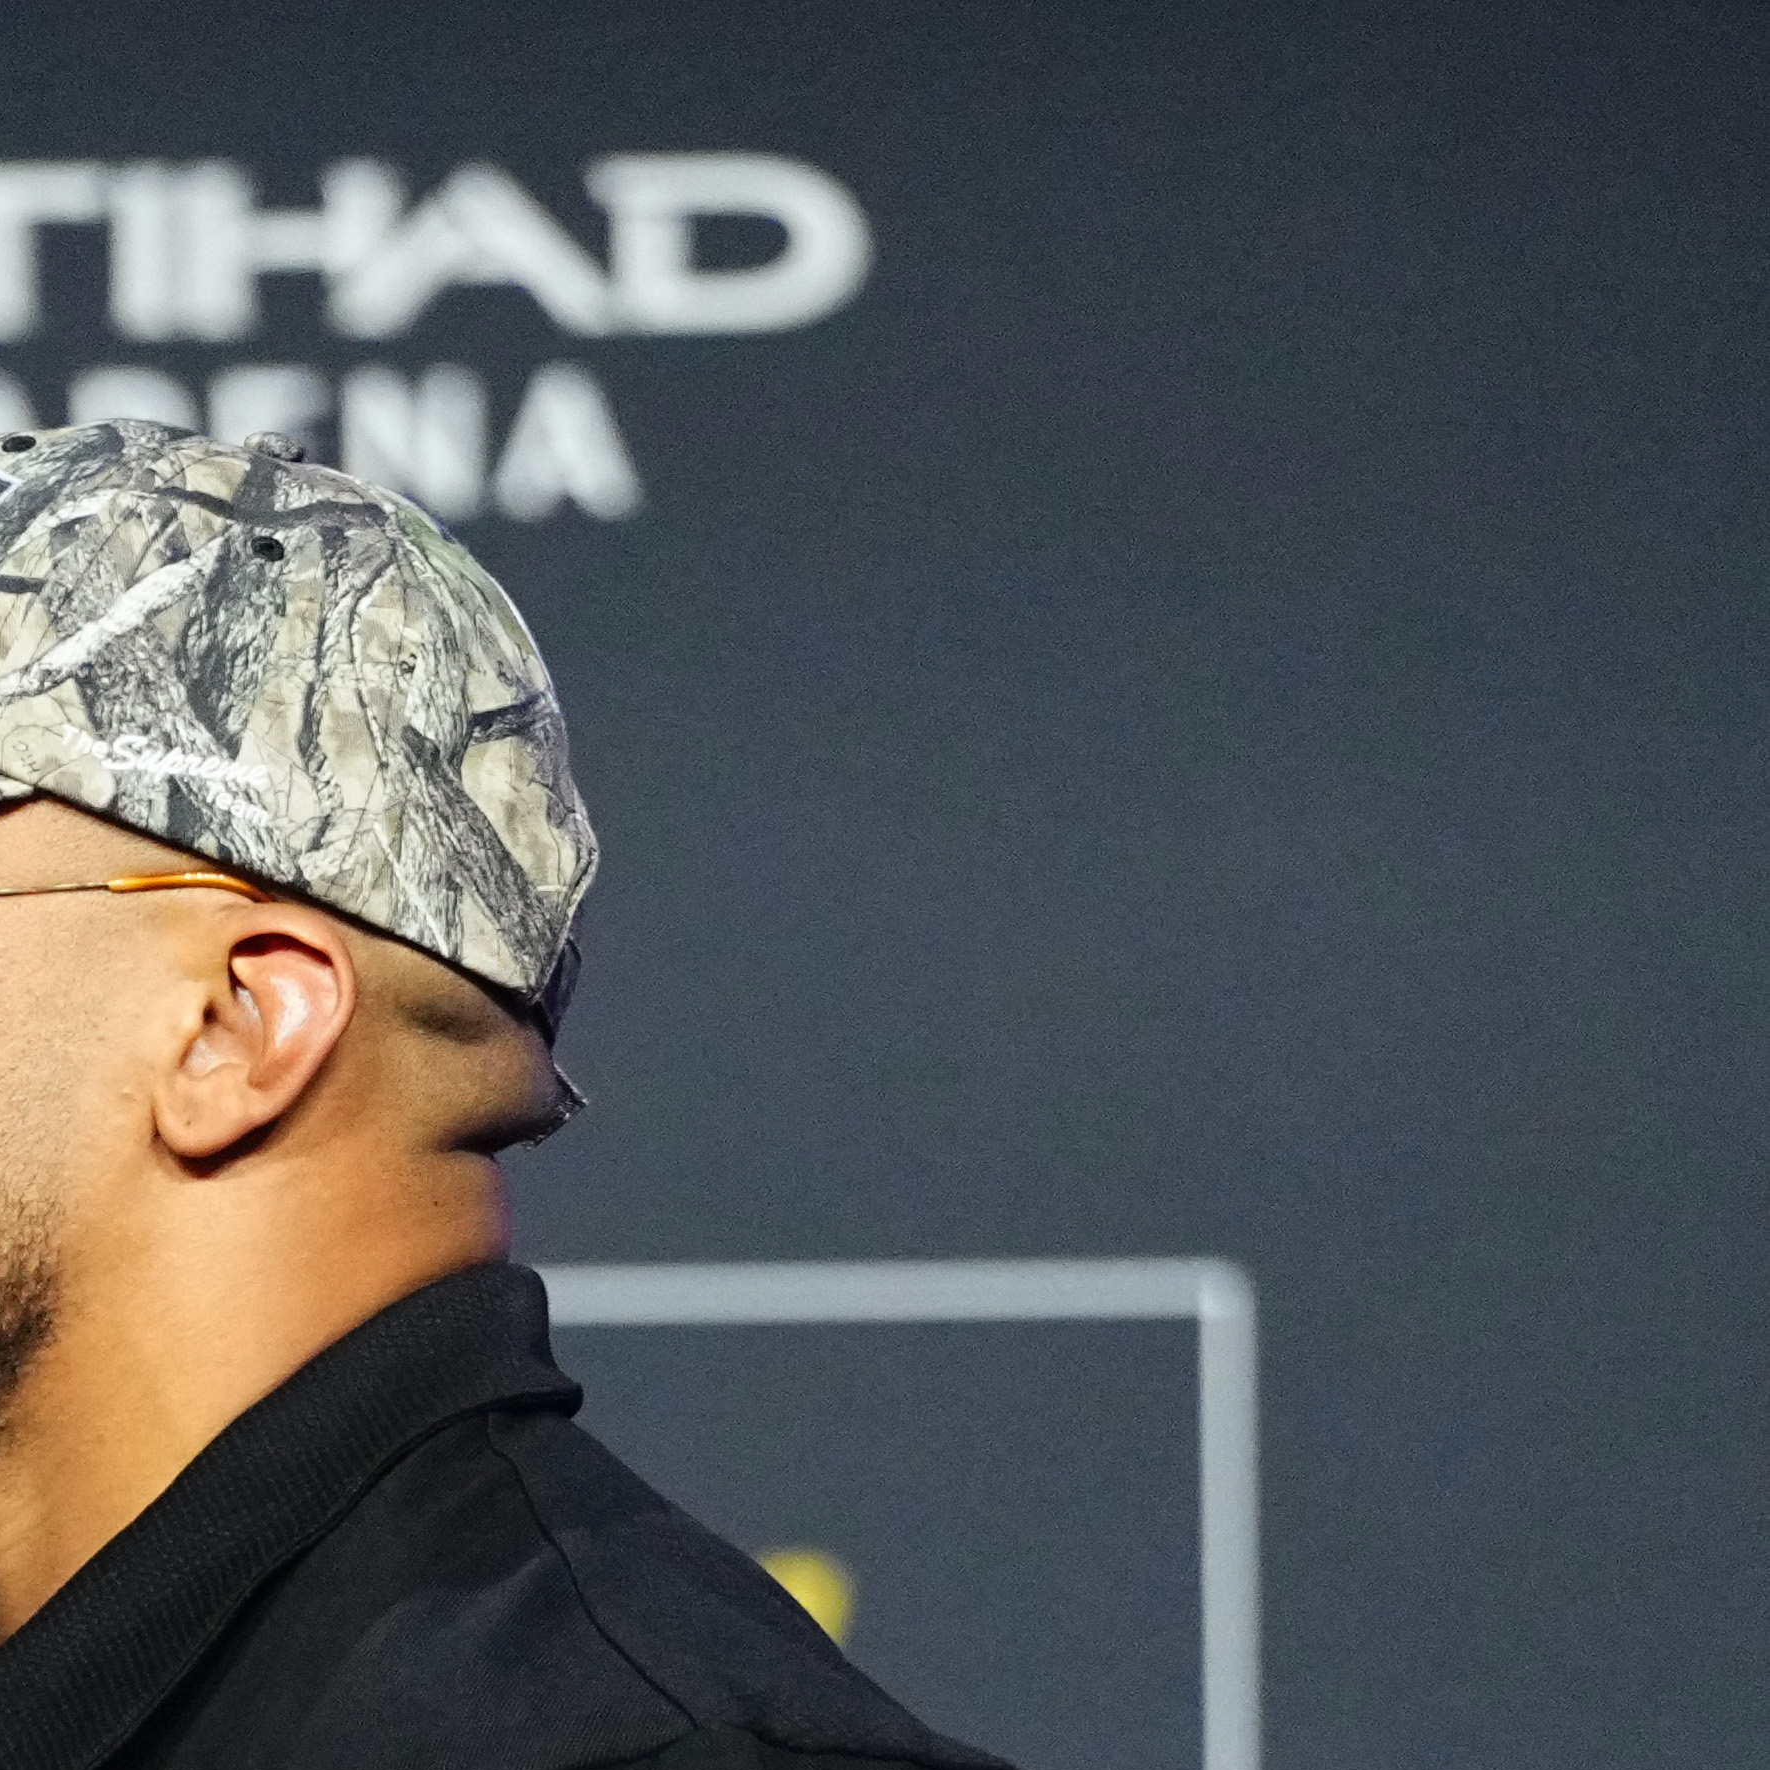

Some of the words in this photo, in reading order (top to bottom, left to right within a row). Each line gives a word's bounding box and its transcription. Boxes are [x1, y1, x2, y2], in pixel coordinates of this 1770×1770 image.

[60, 721, 110, 761] The
[101, 733, 270, 787] Supreme
[206, 779, 270, 827] Team
